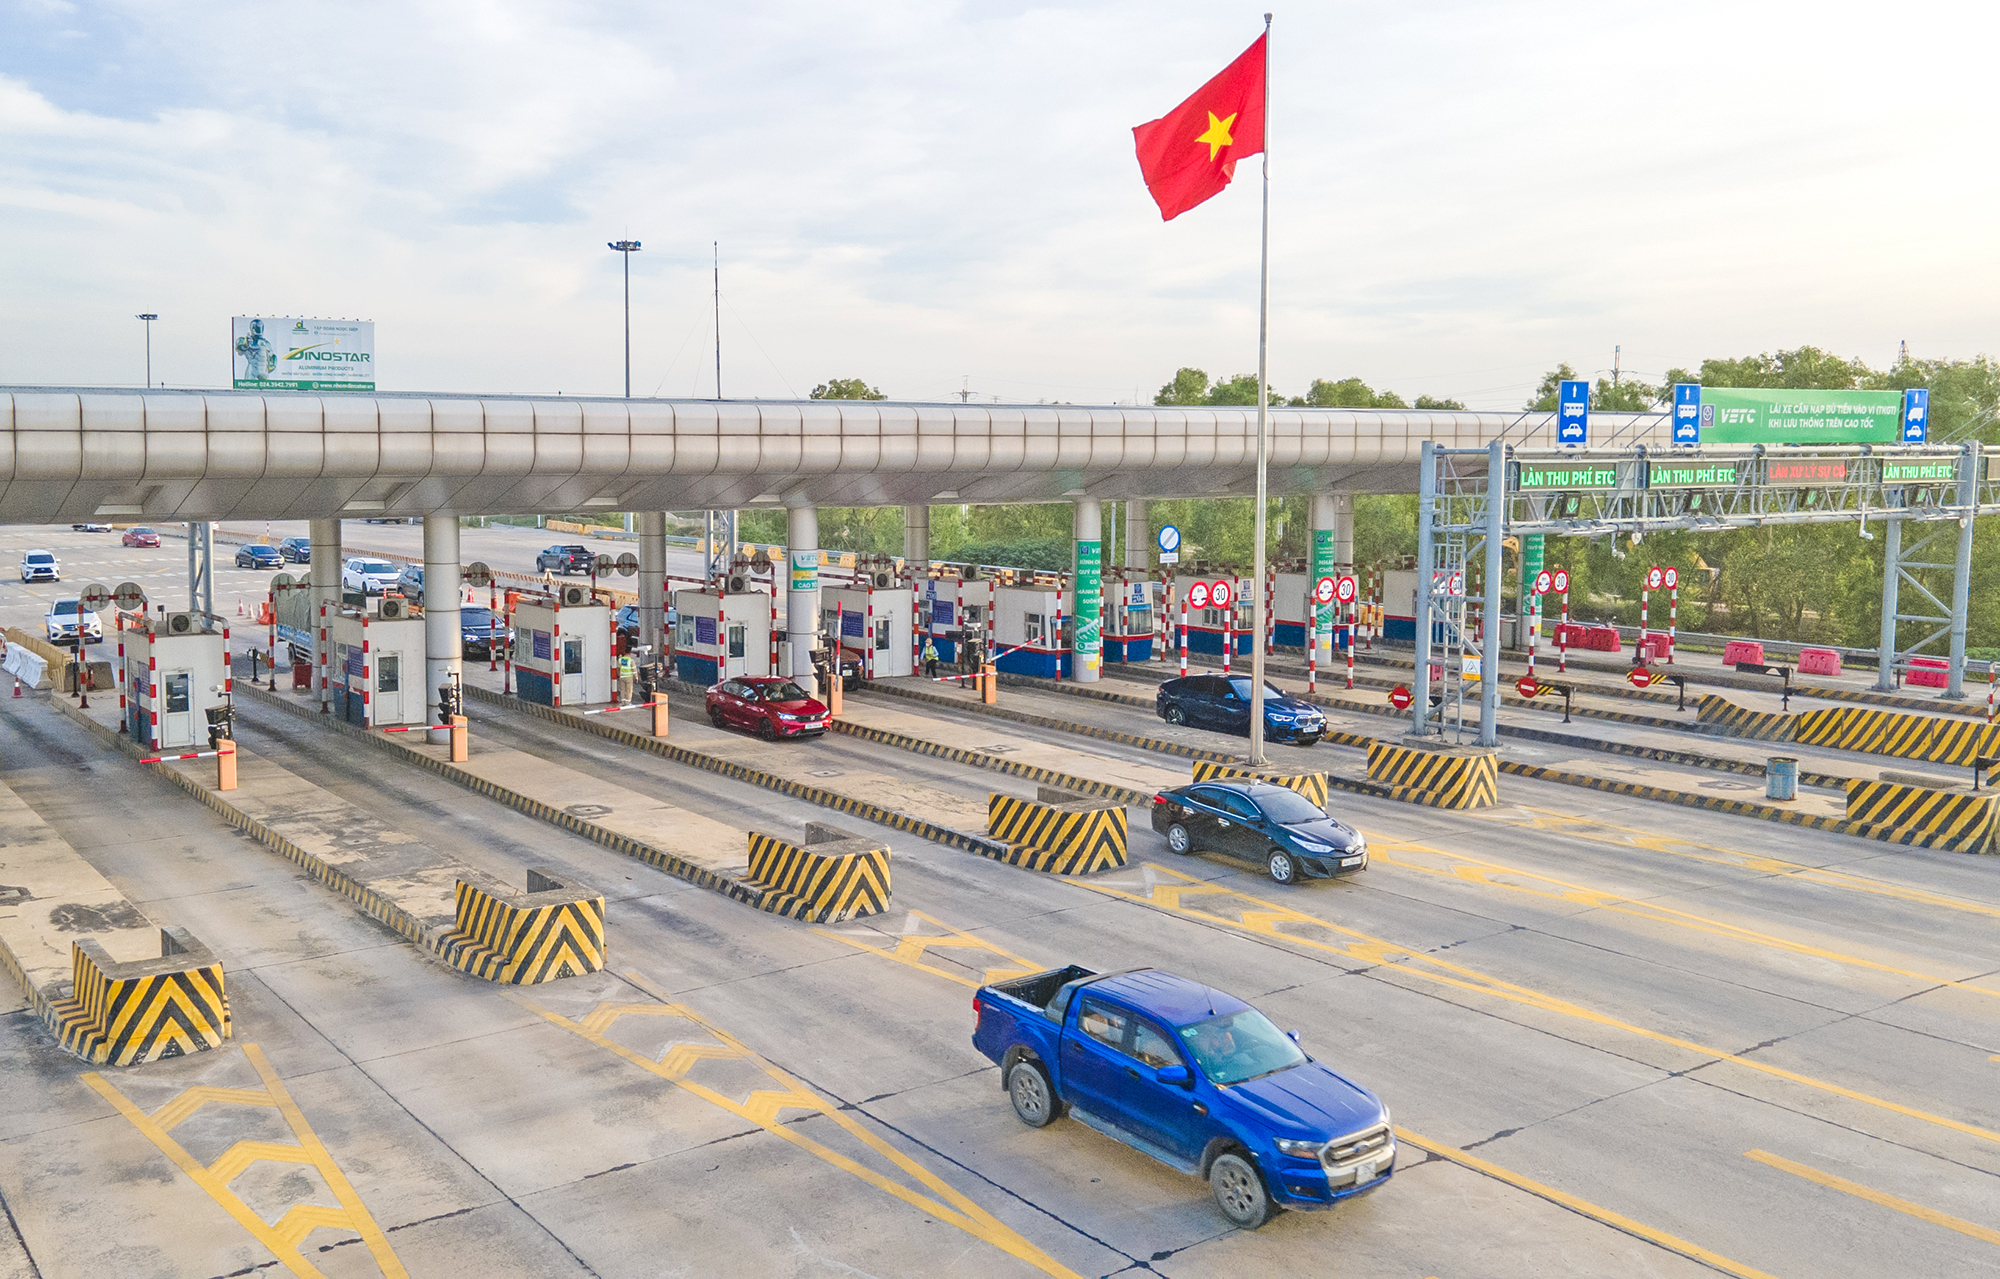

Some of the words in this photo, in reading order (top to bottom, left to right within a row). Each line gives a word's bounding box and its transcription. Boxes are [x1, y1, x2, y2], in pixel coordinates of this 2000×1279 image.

[287, 347, 370, 362] DINOSTAR
[1721, 408, 1756, 424] VETC
[1782, 404, 1792, 414] XE
[1810, 404, 1825, 416] NẠP
[1768, 419, 1782, 428] KHI
[1799, 416, 1824, 428] THÔNG
[1826, 416, 1843, 428] TRÊN
[1844, 418, 1858, 428] CAO
[1860, 416, 1874, 428] TỐC
[1521, 466, 1543, 486] LÀN
[1546, 470, 1570, 486] THU
[1572, 466, 1592, 486] PHÍ
[1594, 470, 1616, 486] ETC
[1650, 465, 1671, 484] LÀN
[1672, 469, 1694, 484] THU
[1695, 464, 1716, 483] PHÍ
[1716, 468, 1736, 483] ETC
[1769, 463, 1788, 478] LÀN
[1804, 463, 1817, 478] LÝ
[1883, 462, 1900, 479] LÀN
[1901, 466, 1919, 479] THU
[1920, 461, 1937, 478] PHÍ
[1938, 465, 1952, 478] ETC
[1556, 576, 1565, 587] 30
[1667, 572, 1675, 584] 30
[1215, 588, 1226, 601] 30
[1340, 584, 1350, 596] 30
